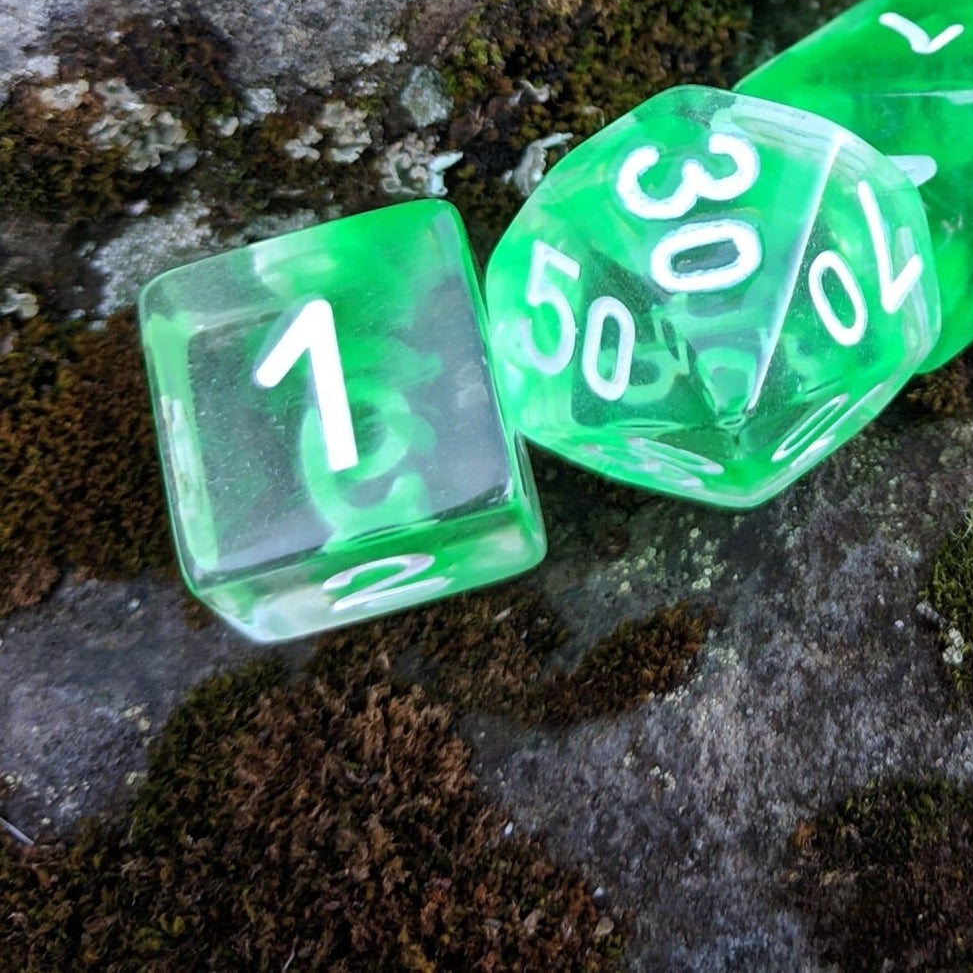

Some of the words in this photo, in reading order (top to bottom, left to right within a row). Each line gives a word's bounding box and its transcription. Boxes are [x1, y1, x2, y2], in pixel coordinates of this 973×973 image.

[616, 132, 764, 293] 30
[255, 298, 360, 472] 1
[519, 240, 636, 402] 50
[322, 553, 457, 613] 2
